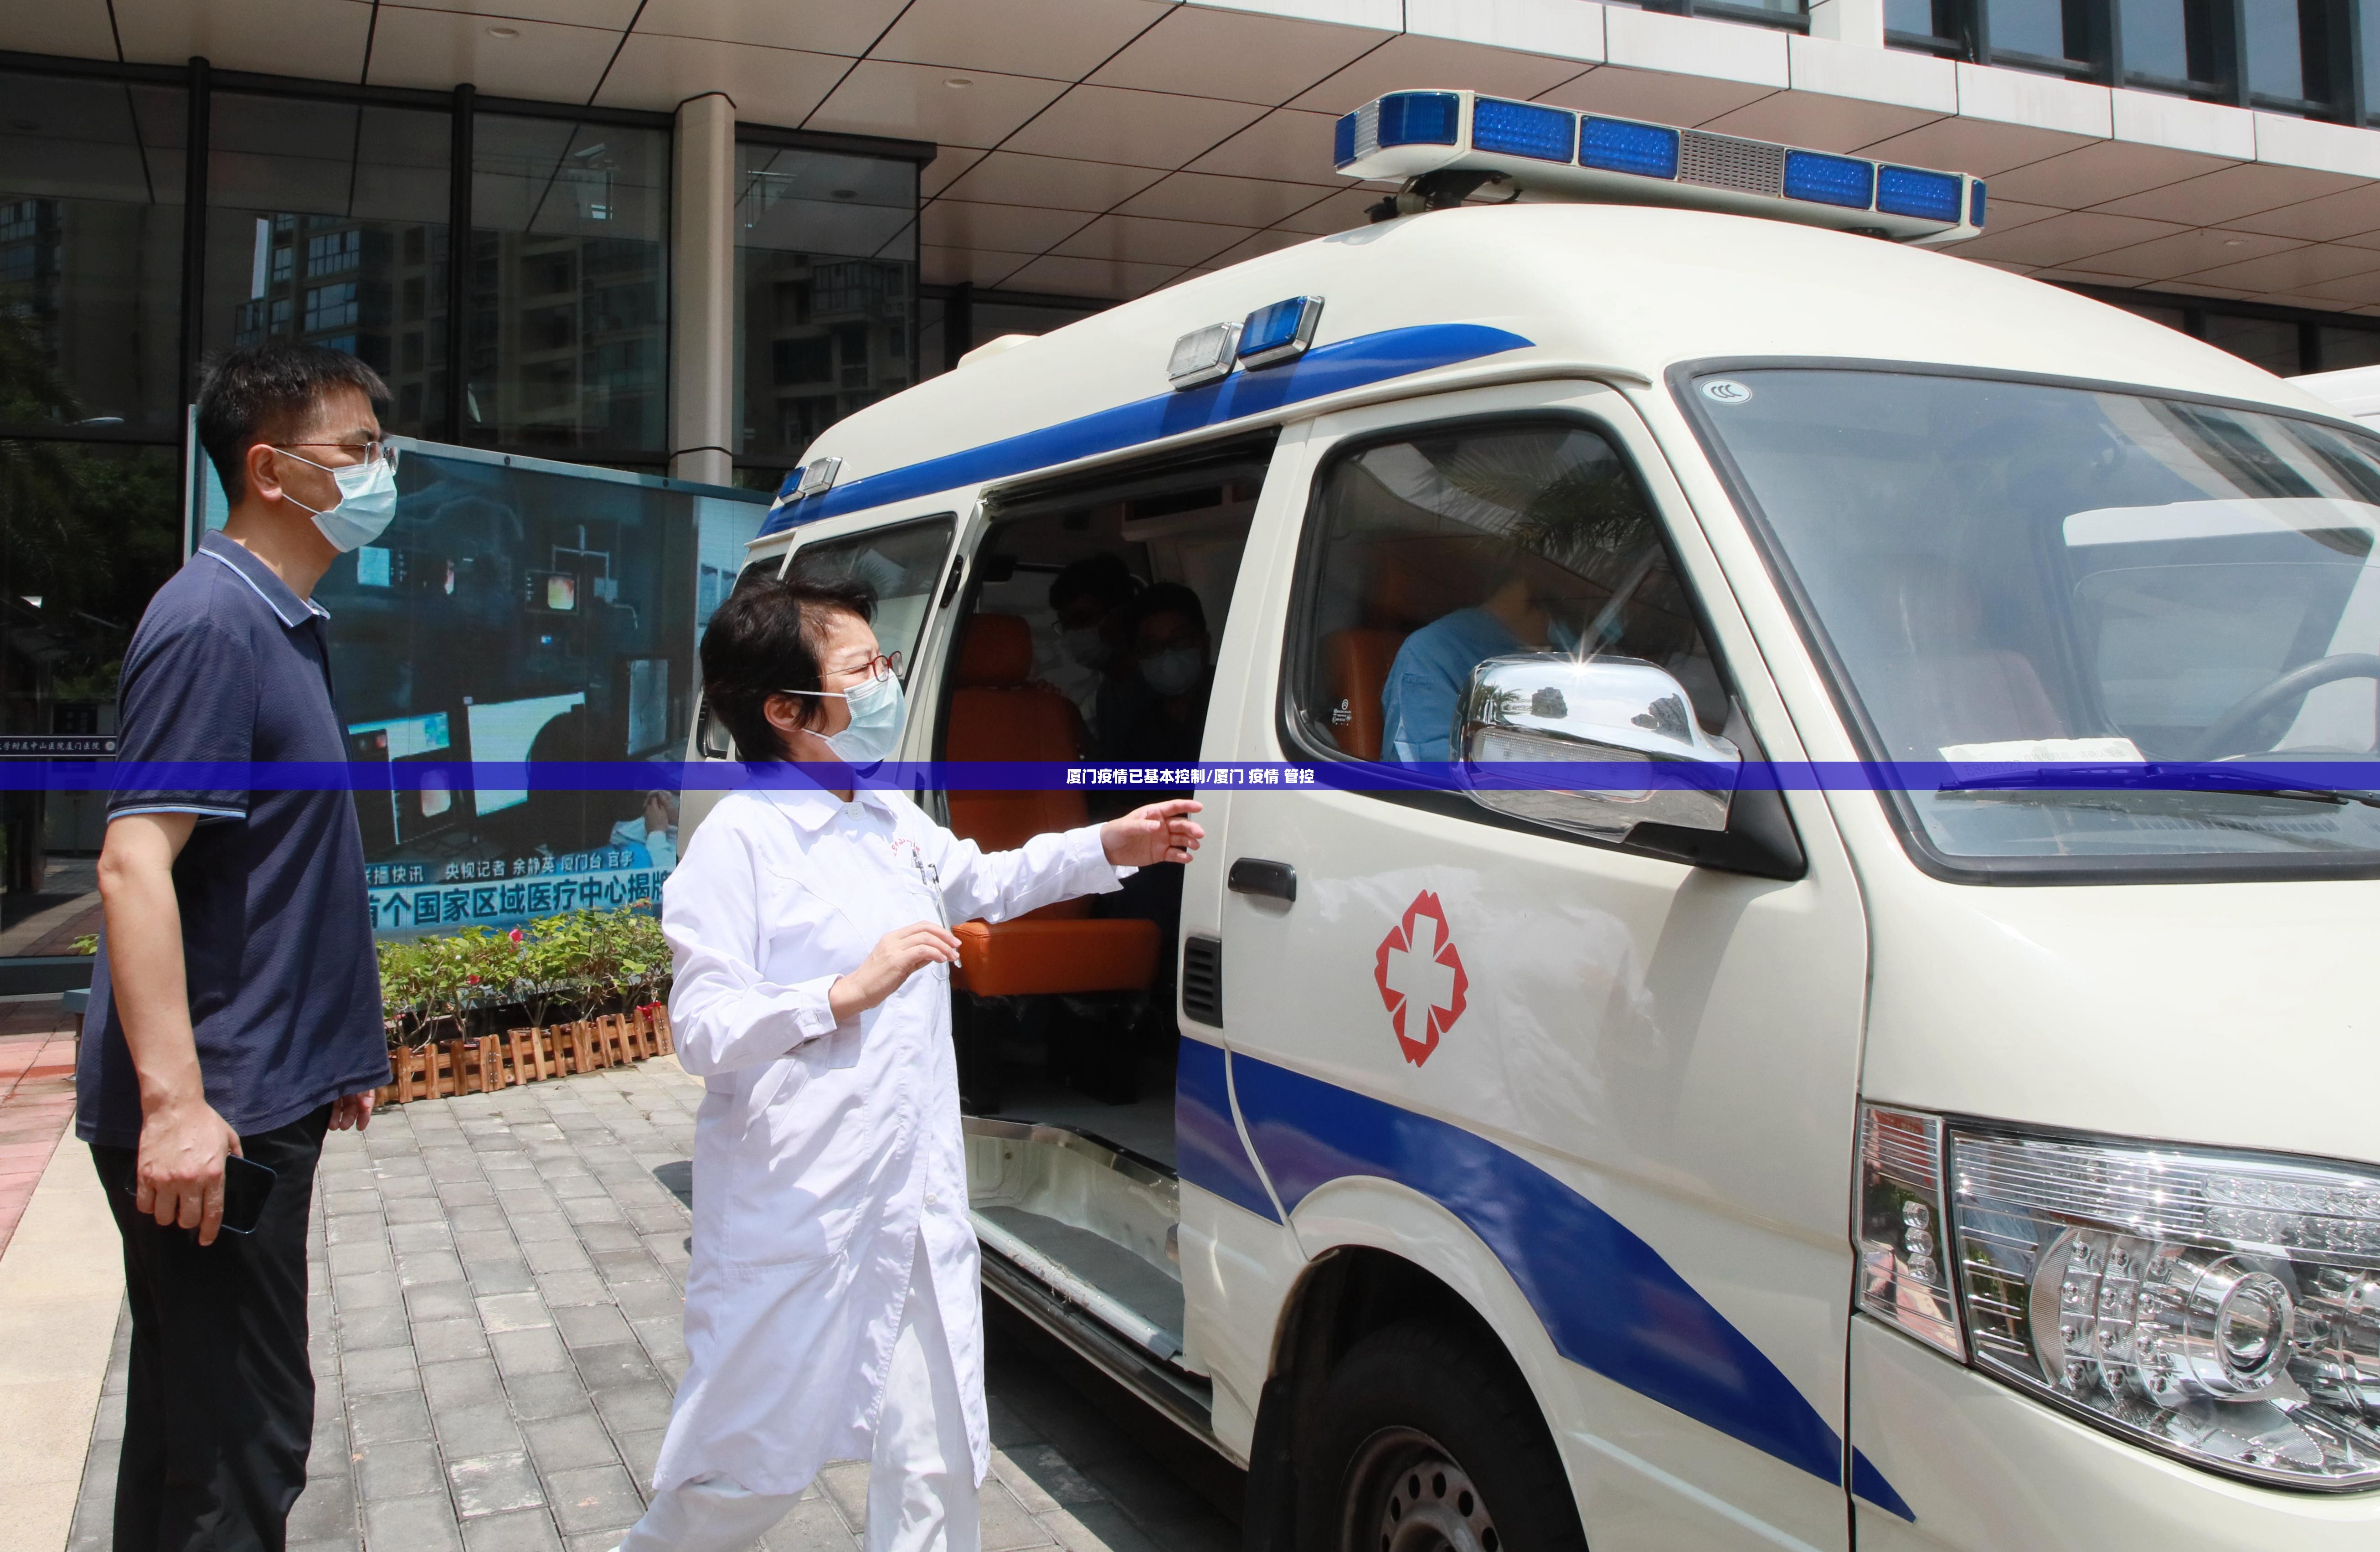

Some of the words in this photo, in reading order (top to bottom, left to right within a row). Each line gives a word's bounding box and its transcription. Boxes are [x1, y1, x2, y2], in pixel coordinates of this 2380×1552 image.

[0, 741, 100, 751] 学附属中山医院厦门医院
